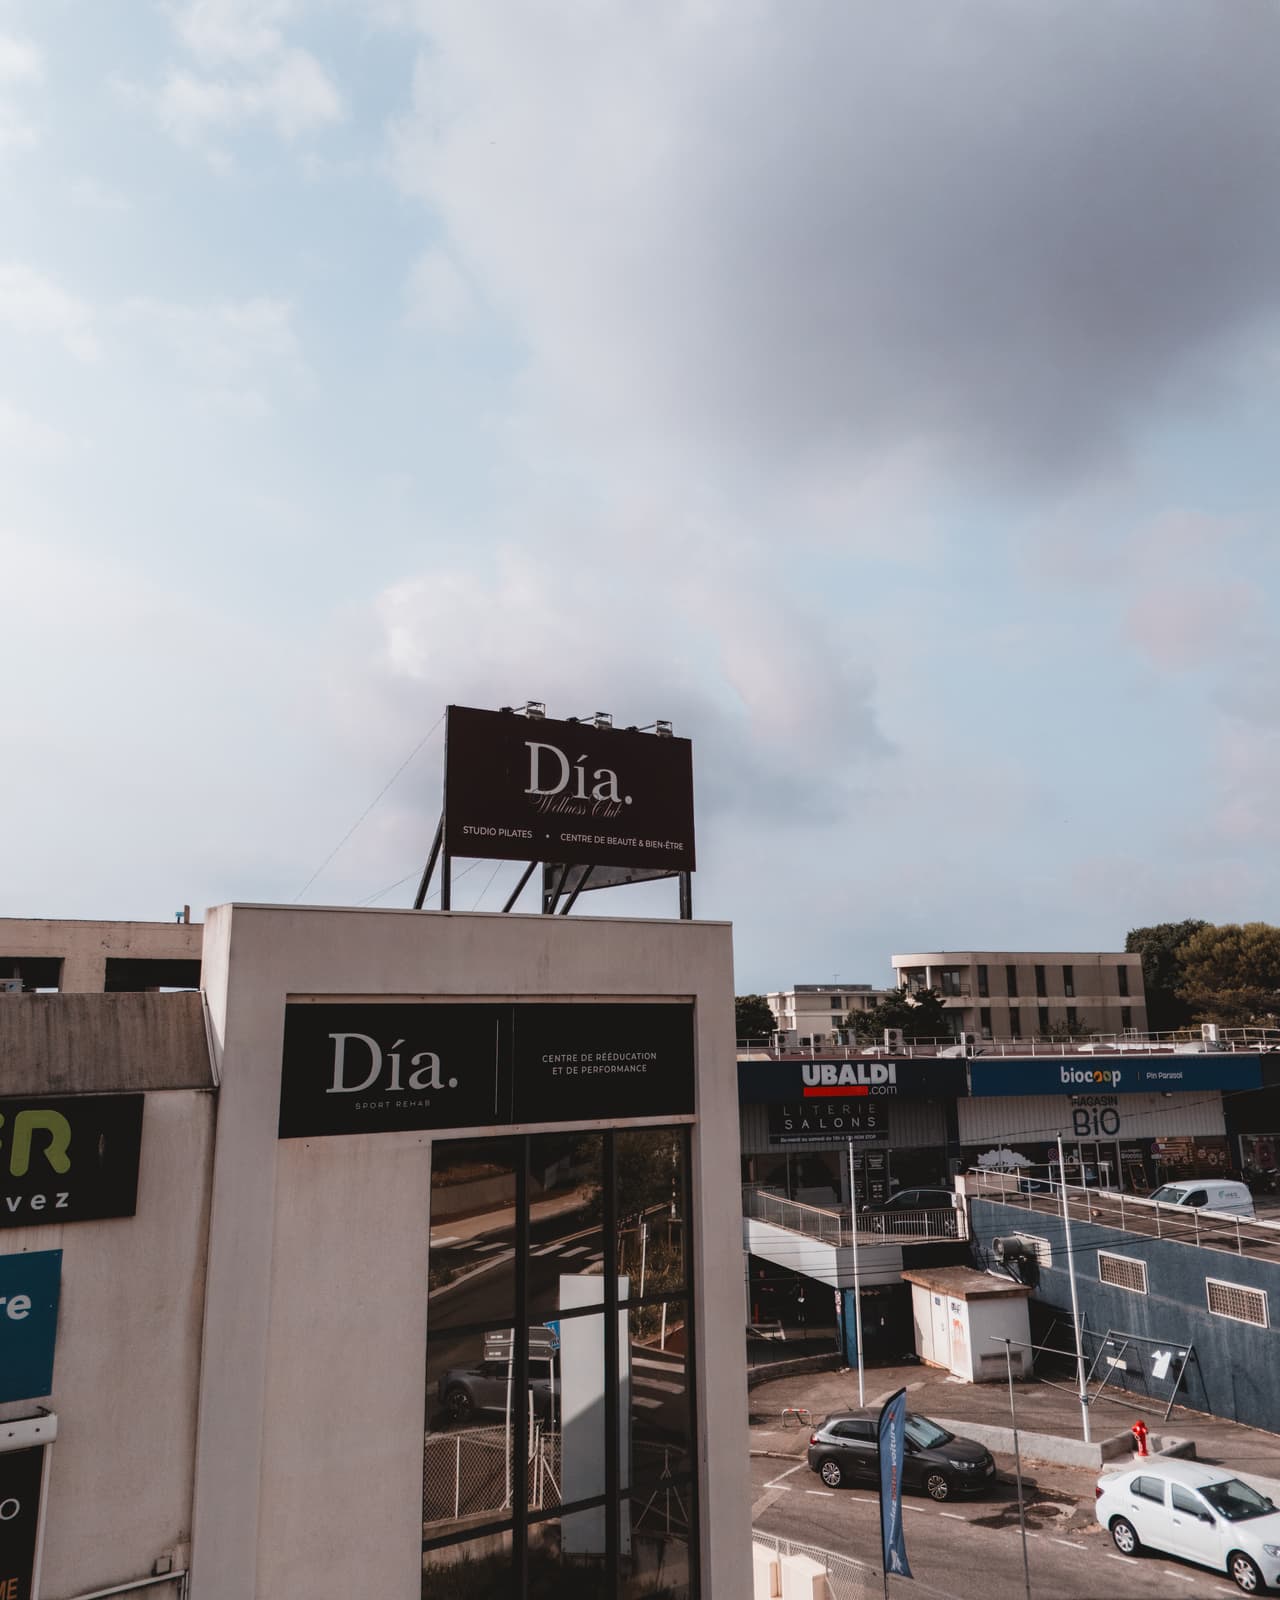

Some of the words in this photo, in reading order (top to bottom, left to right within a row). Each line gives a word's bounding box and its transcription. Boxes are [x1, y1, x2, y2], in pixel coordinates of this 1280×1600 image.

[524, 741, 633, 805] Día.
[533, 794, 586, 815] Wellness
[463, 825, 497, 836] STUDIO
[498, 828, 533, 839] PILATES
[560, 833, 593, 844] CENTRE
[594, 836, 606, 845] DE
[607, 837, 637, 847] BEAUTÉ
[645, 840, 684, 851] BIEN-ÊTRE
[326, 1032, 459, 1094] Día.
[542, 1054, 578, 1063] CENTRE
[581, 1053, 593, 1062] DE
[595, 1052, 657, 1062] RÉÉDUCATION
[552, 1067, 563, 1075] ET
[566, 1066, 579, 1075] DE
[581, 1064, 647, 1074] PERFORMANCE
[802, 1063, 897, 1086] UBALDI
[1060, 1066, 1121, 1088] biocoop
[869, 1086, 897, 1095] .com
[355, 1101, 391, 1110] SPORT
[783, 1103, 876, 1116] LITERIE
[784, 1116, 876, 1130] SALONS
